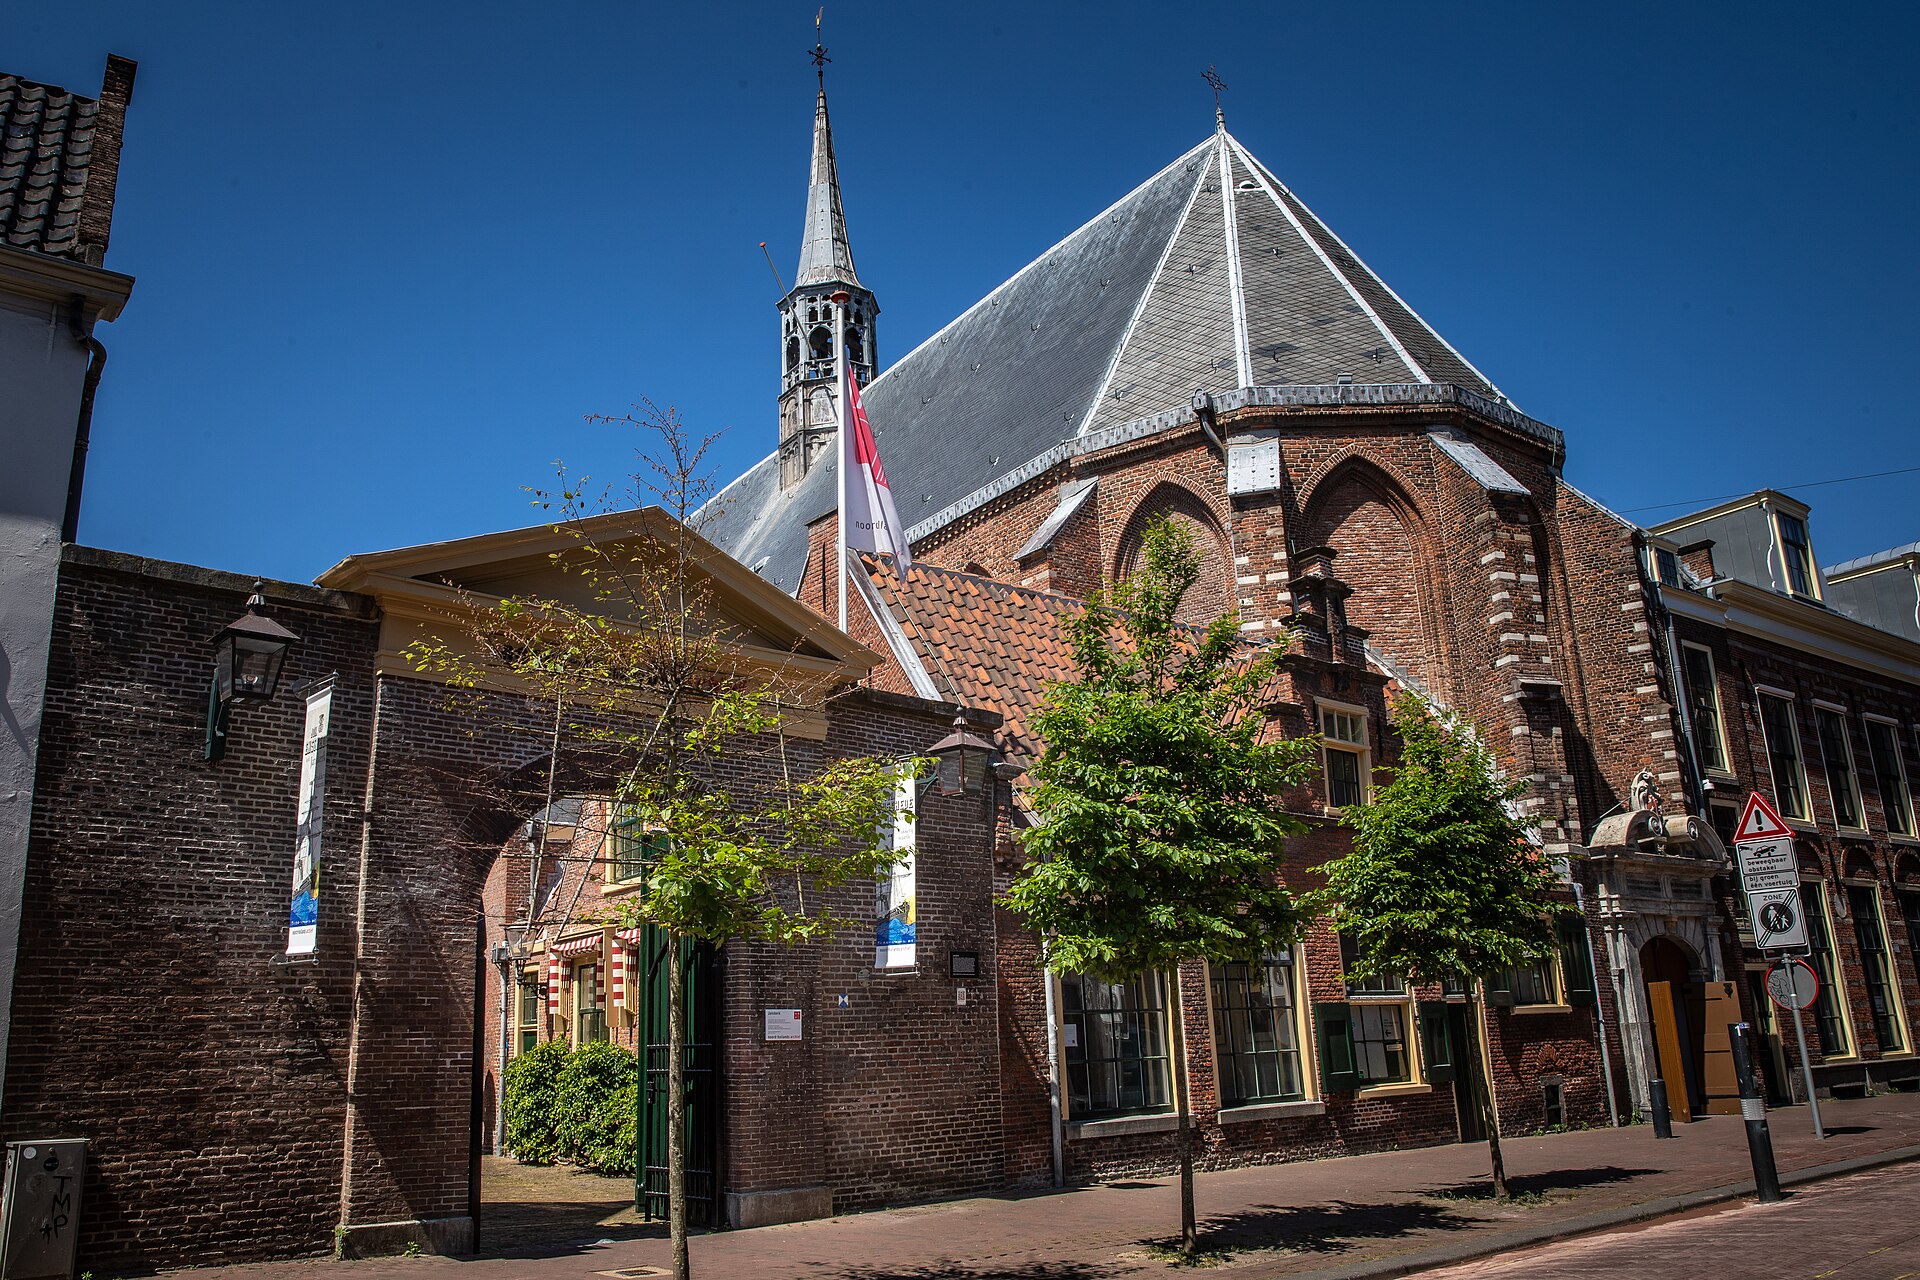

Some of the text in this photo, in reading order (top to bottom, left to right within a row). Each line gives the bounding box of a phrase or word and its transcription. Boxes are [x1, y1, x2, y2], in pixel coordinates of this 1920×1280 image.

[1747, 857, 1787, 866] beweegbaar
[1748, 864, 1777, 873] obstakel
[1764, 879, 1793, 887] voertuig
[1762, 893, 1784, 901] ZONE
